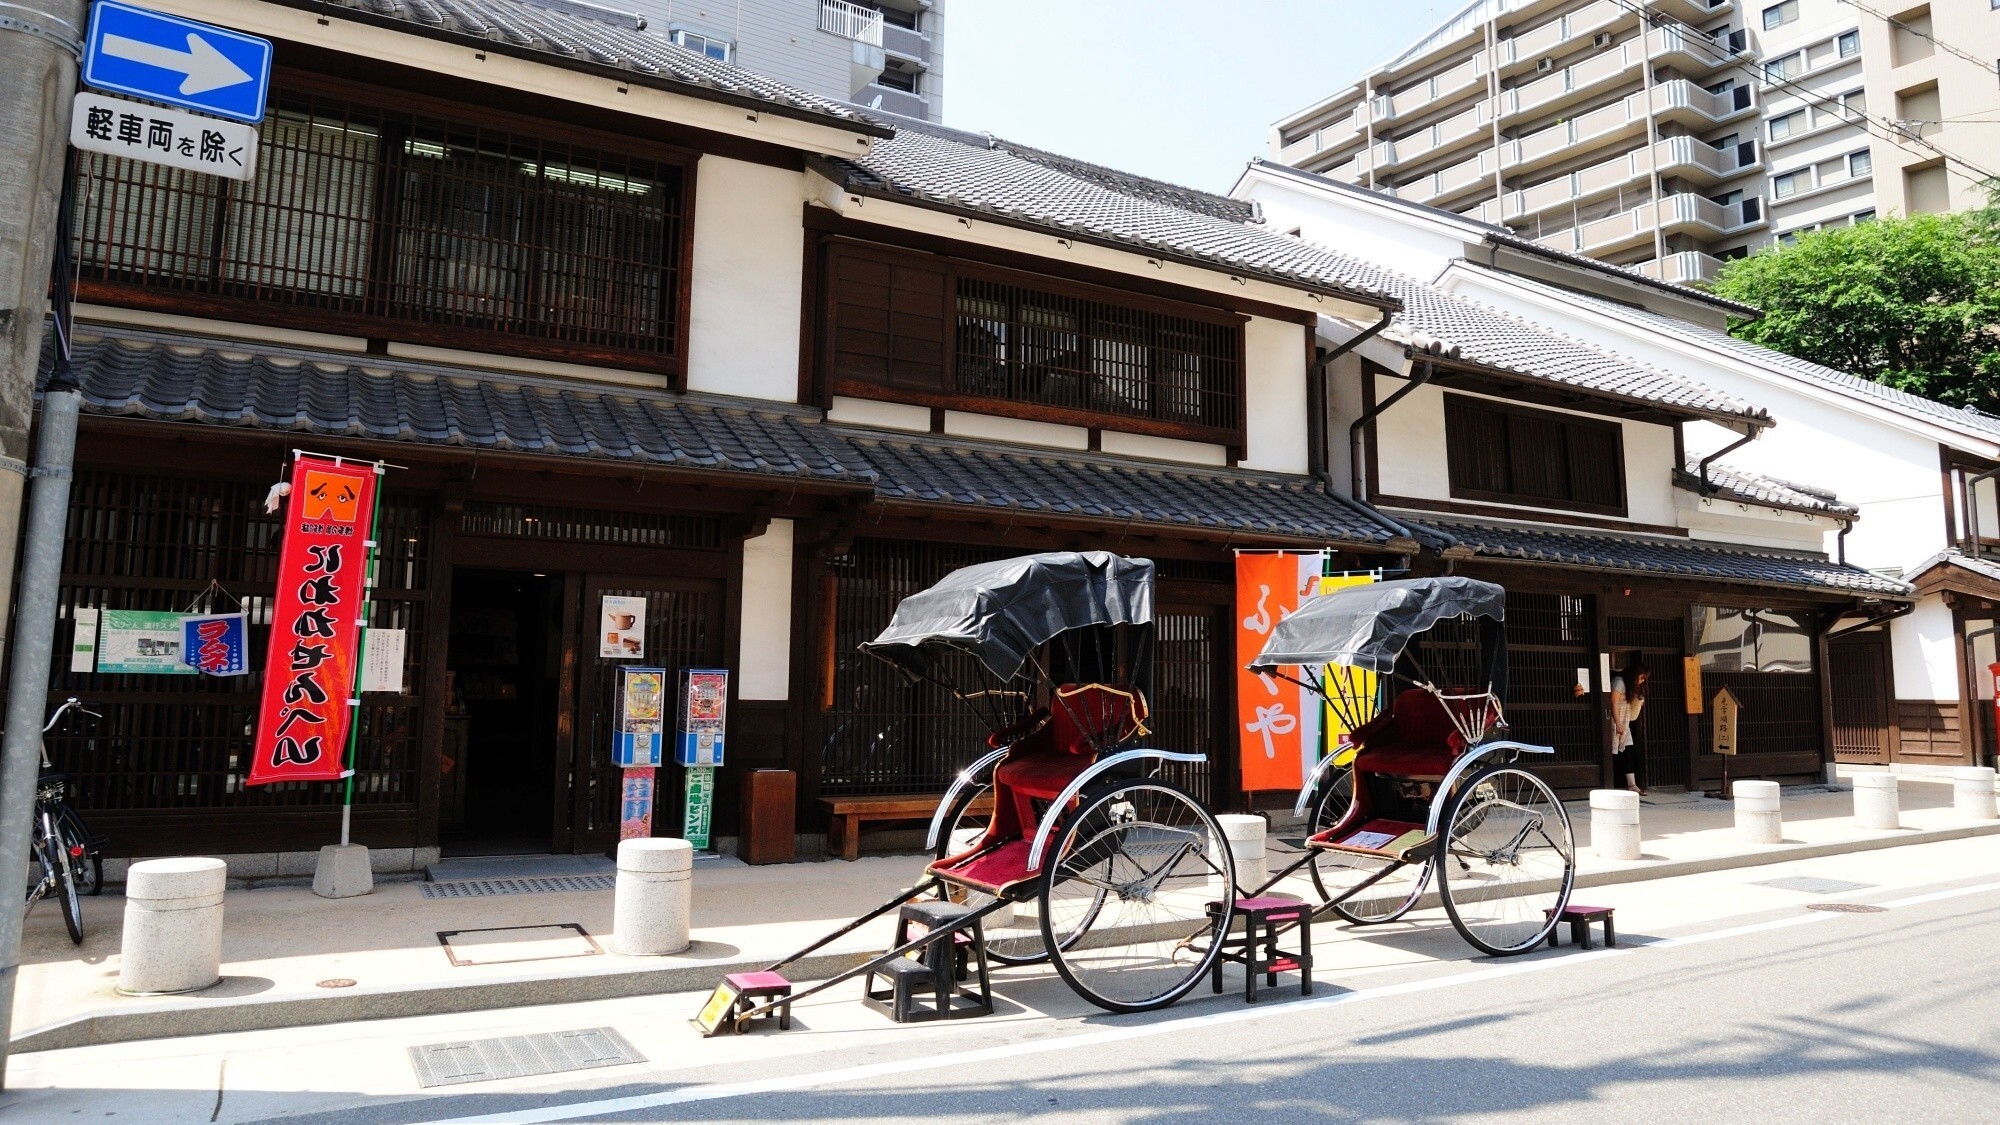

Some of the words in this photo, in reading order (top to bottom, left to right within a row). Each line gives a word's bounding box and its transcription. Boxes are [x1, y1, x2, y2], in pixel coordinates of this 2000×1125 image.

[85, 105, 244, 167] 軽車両を除く
[197, 620, 230, 672] ラムネ
